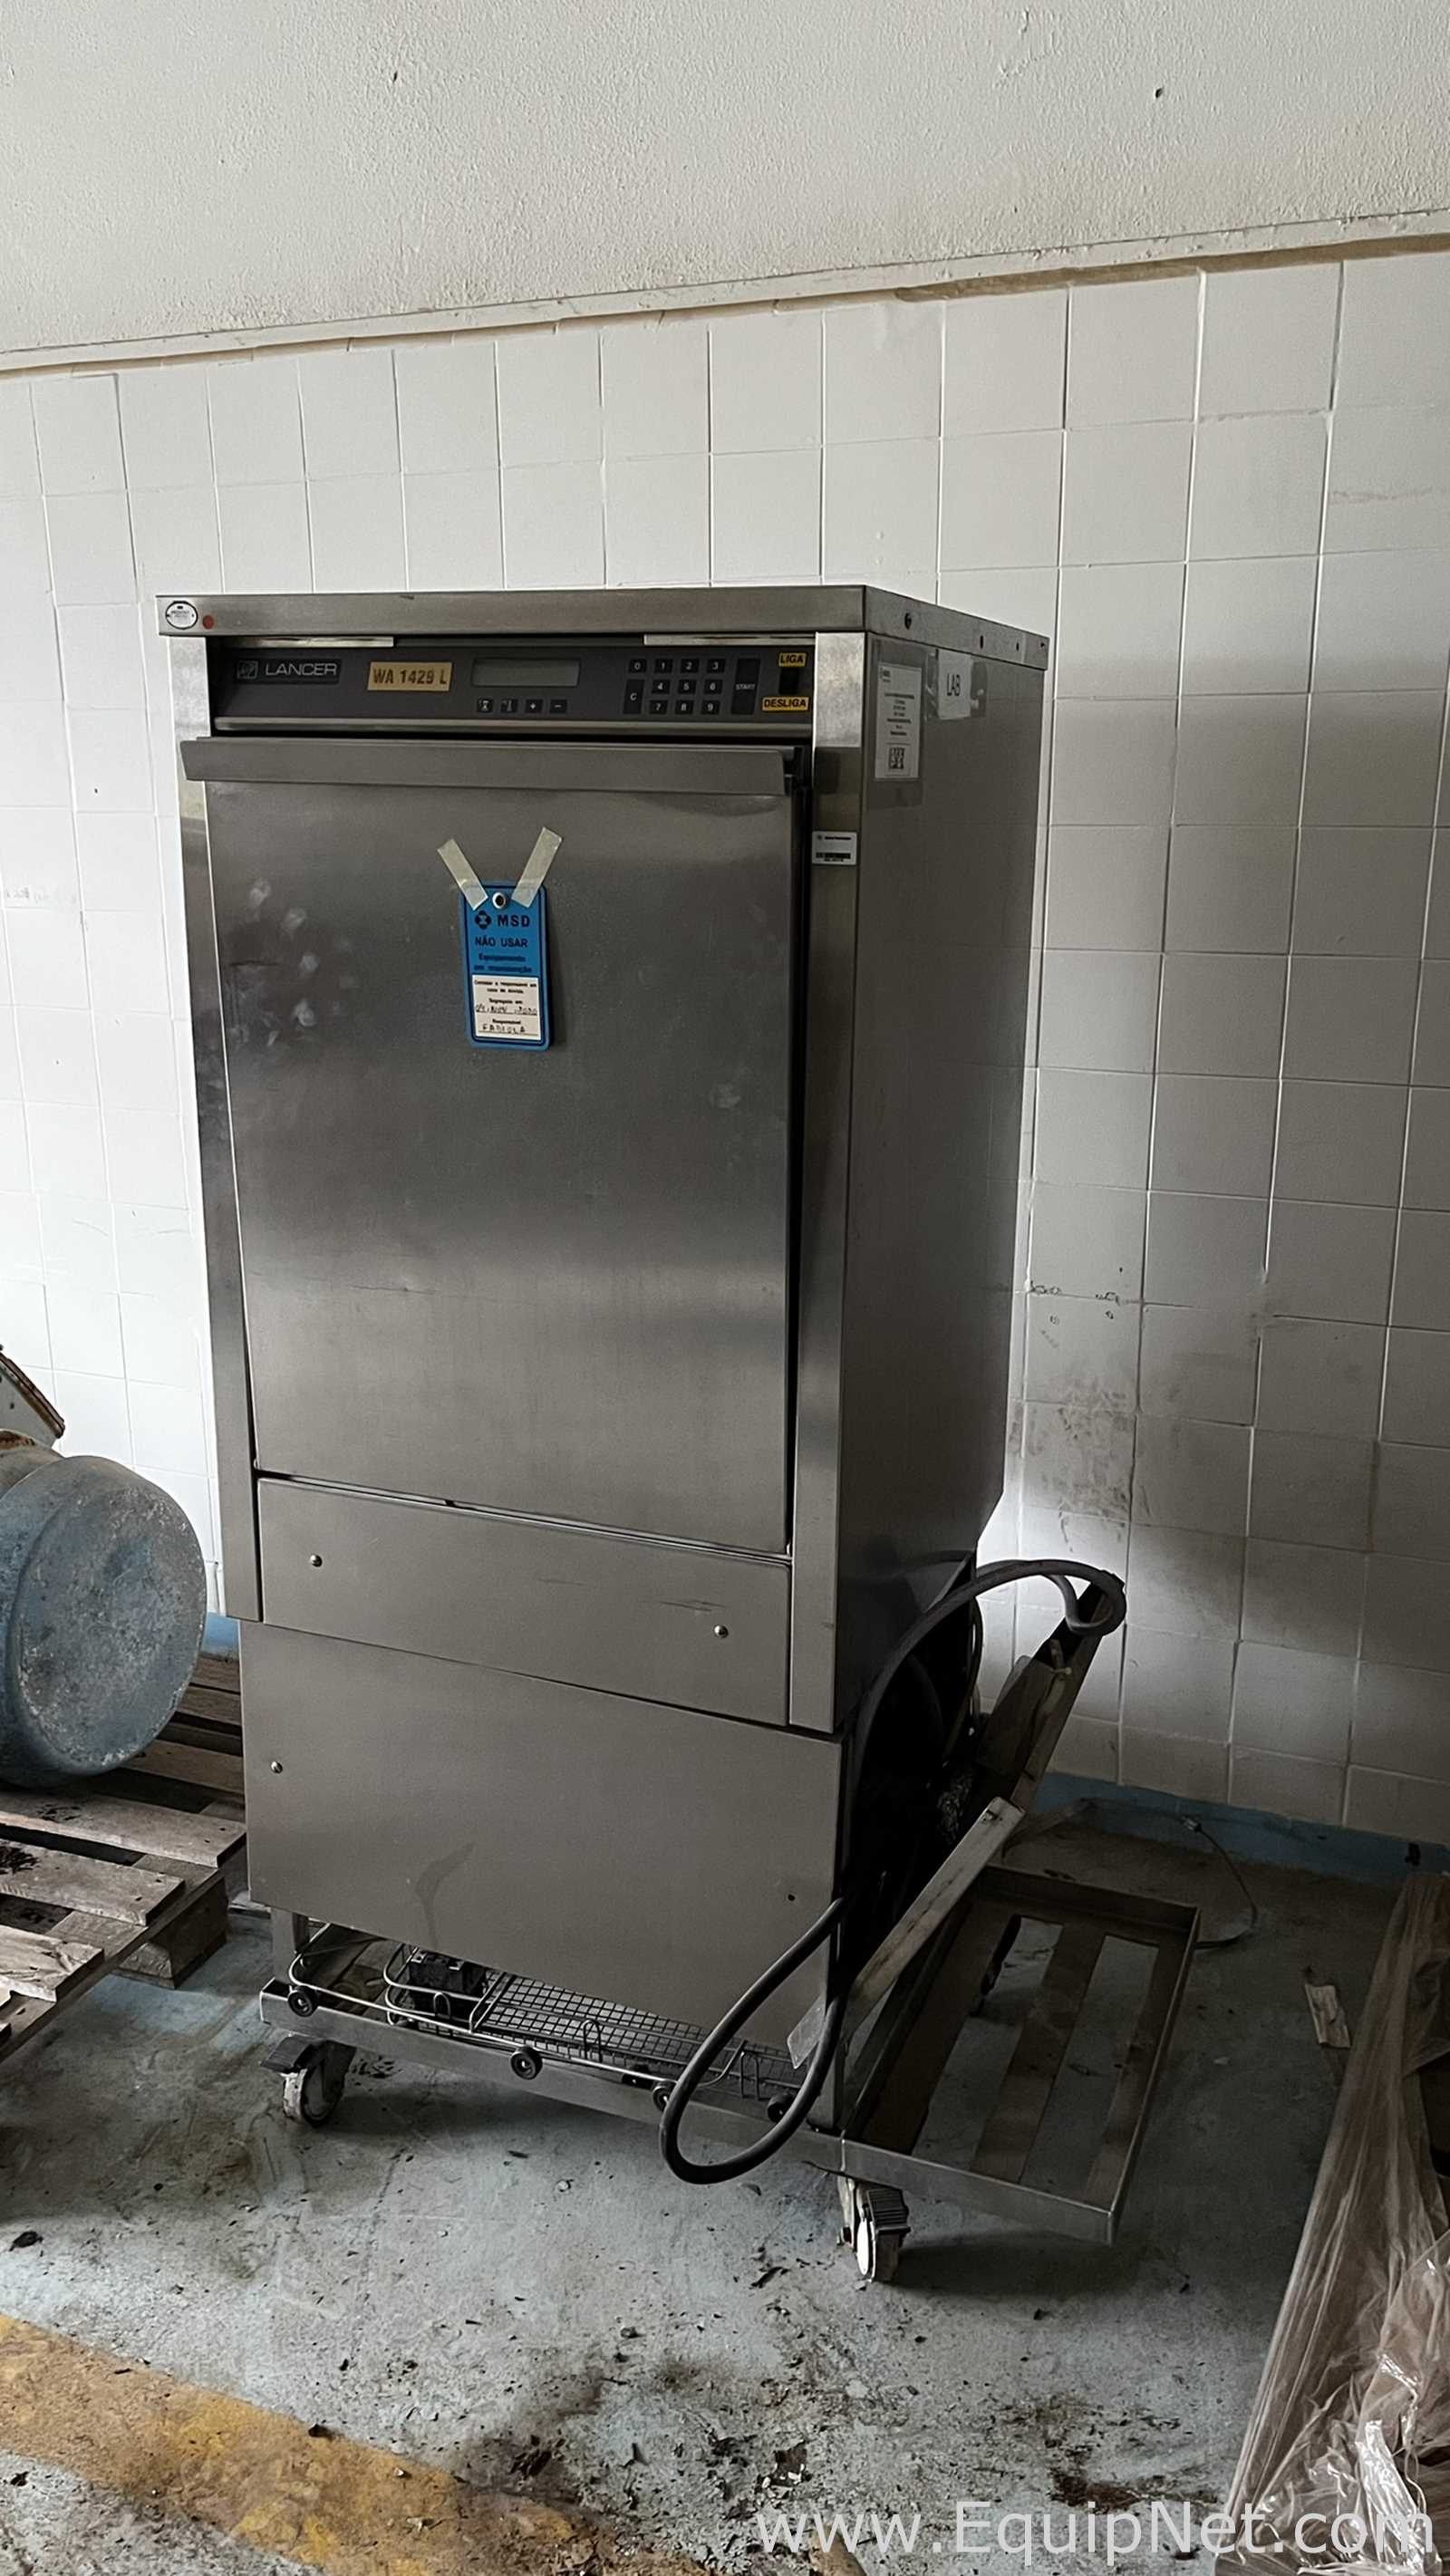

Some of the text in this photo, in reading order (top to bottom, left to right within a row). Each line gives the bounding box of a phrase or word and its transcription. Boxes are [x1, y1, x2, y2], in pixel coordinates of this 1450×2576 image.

[780, 653, 805, 664] LIGA
[265, 662, 338, 677] LANCER
[633, 661, 642, 671] 0
[685, 661, 693, 671] 2
[711, 661, 720, 671] 3
[372, 668, 449, 685] WA 1429 L
[656, 682, 717, 690] 4 5 6
[630, 692, 638, 701] C
[654, 703, 714, 711] 7 8 9
[763, 699, 807, 709] DESLIGA
[497, 914, 531, 928] MSD
[500, 937, 529, 948] USAR
